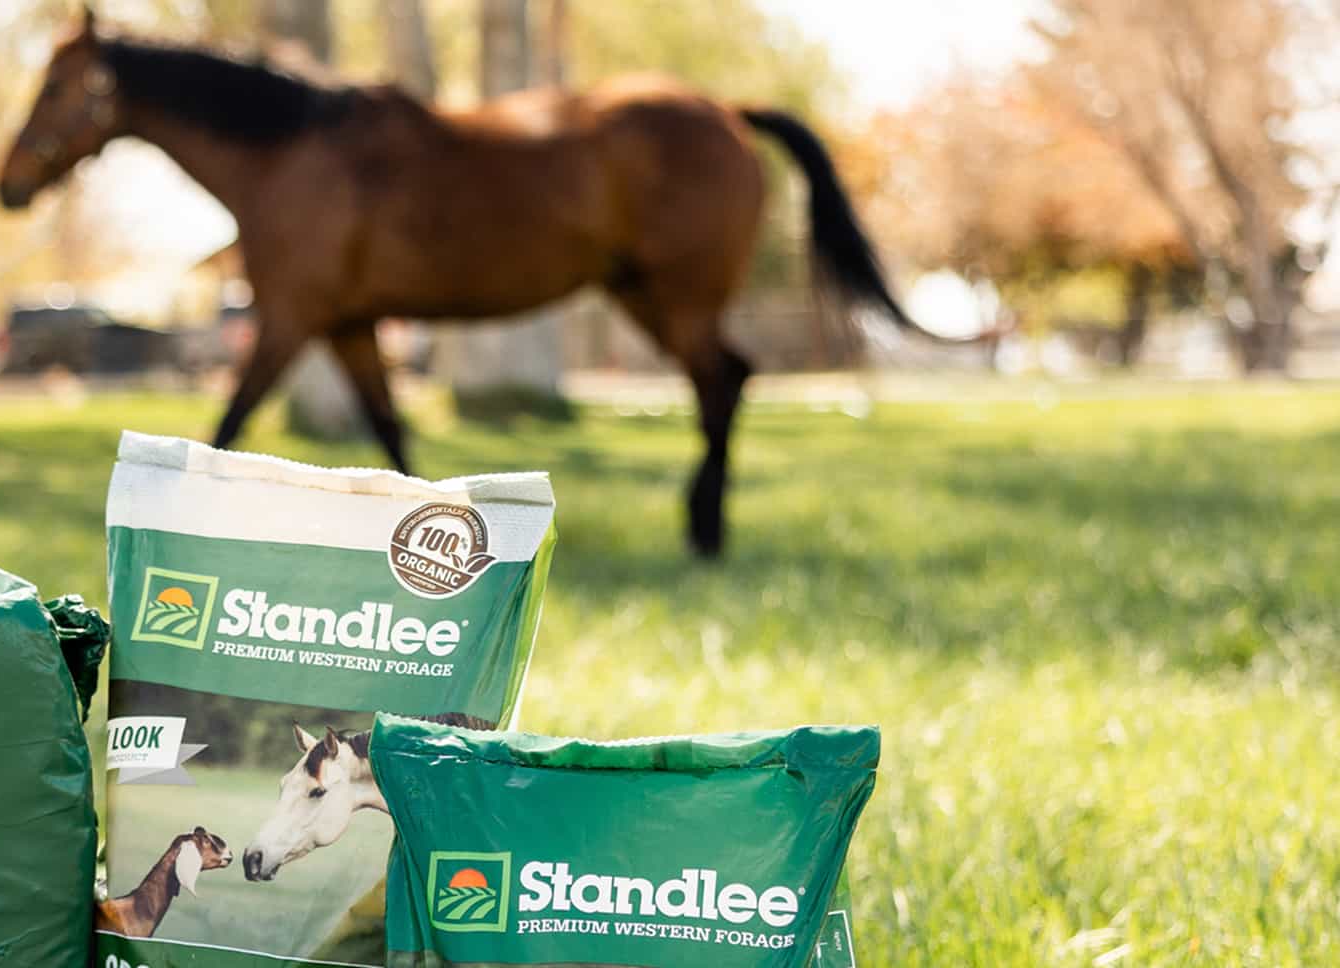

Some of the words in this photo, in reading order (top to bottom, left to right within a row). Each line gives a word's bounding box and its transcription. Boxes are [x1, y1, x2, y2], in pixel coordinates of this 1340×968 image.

[396, 552, 461, 586] ORGANIC
[217, 588, 460, 657] Standlee
[212, 641, 294, 664] PREMIUM
[297, 650, 382, 671] WESTERN
[384, 659, 455, 678] FORAGE
[112, 725, 164, 750] LOOK
[518, 860, 799, 927] Standlee
[517, 920, 608, 935] PREMIUM
[614, 923, 709, 942] WESTERN
[713, 930, 795, 949] FORAGE
